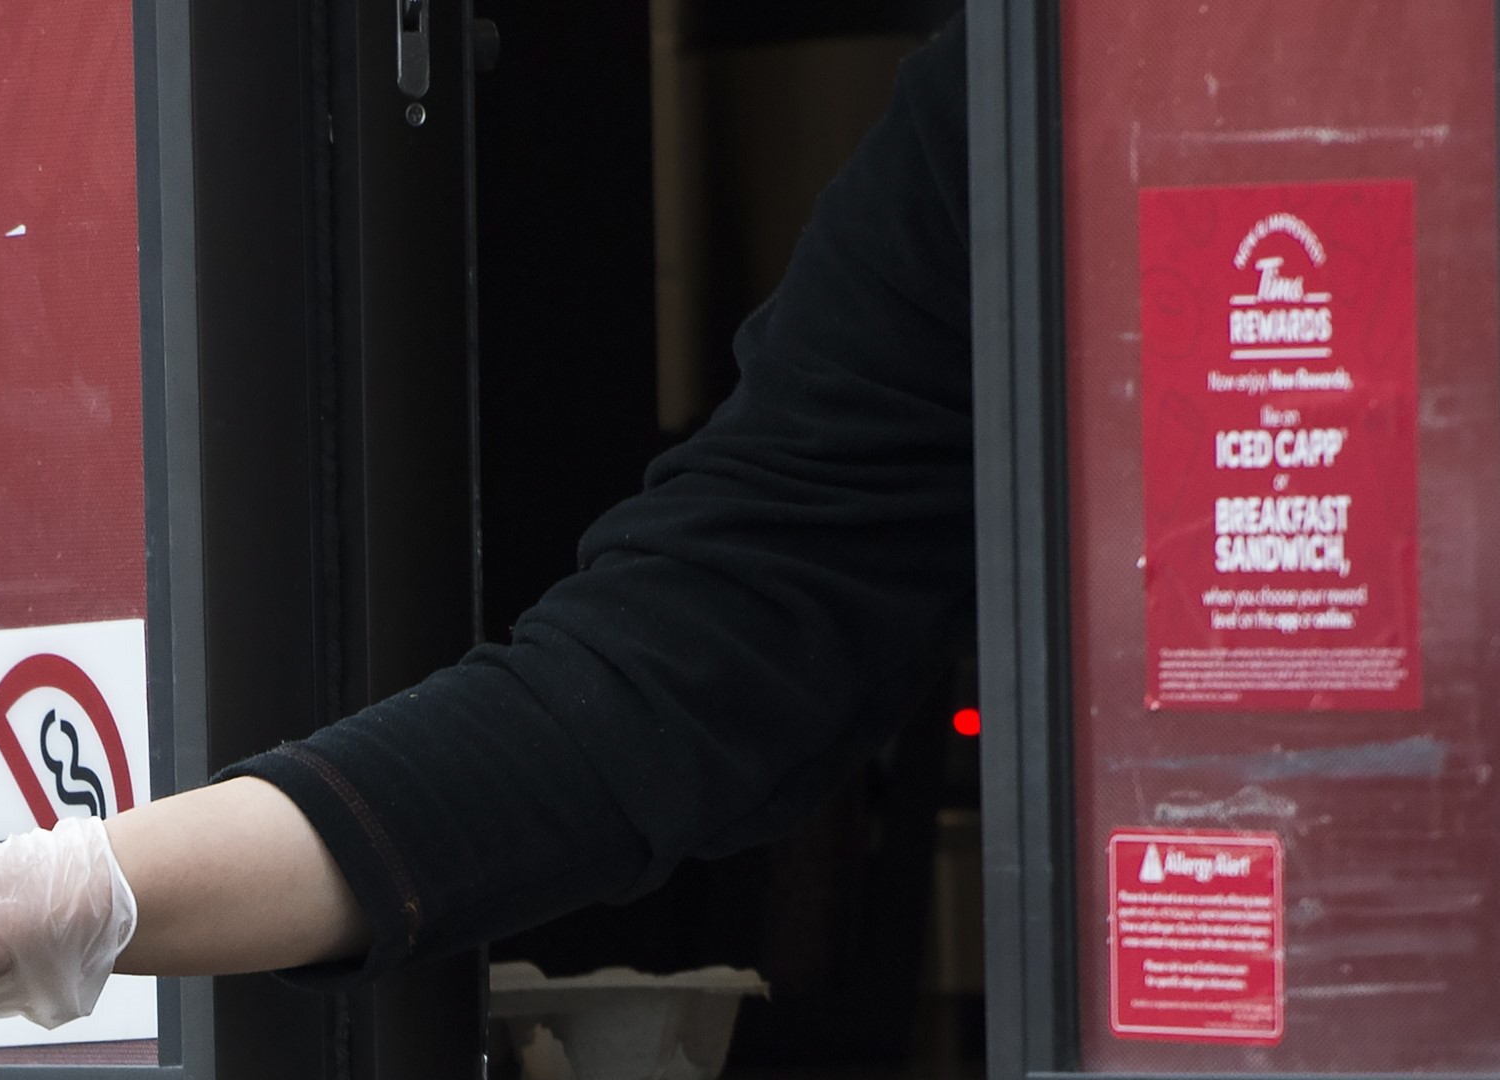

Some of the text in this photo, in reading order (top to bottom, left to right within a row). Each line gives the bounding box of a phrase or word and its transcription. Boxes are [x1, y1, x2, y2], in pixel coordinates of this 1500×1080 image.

[1229, 308, 1332, 344] REWARDS
[1216, 431, 1273, 468] ICED
[1215, 496, 1351, 534] BREAKFAST
[1215, 534, 1350, 578] SANDWICH,
[1164, 848, 1213, 882] Allergy
